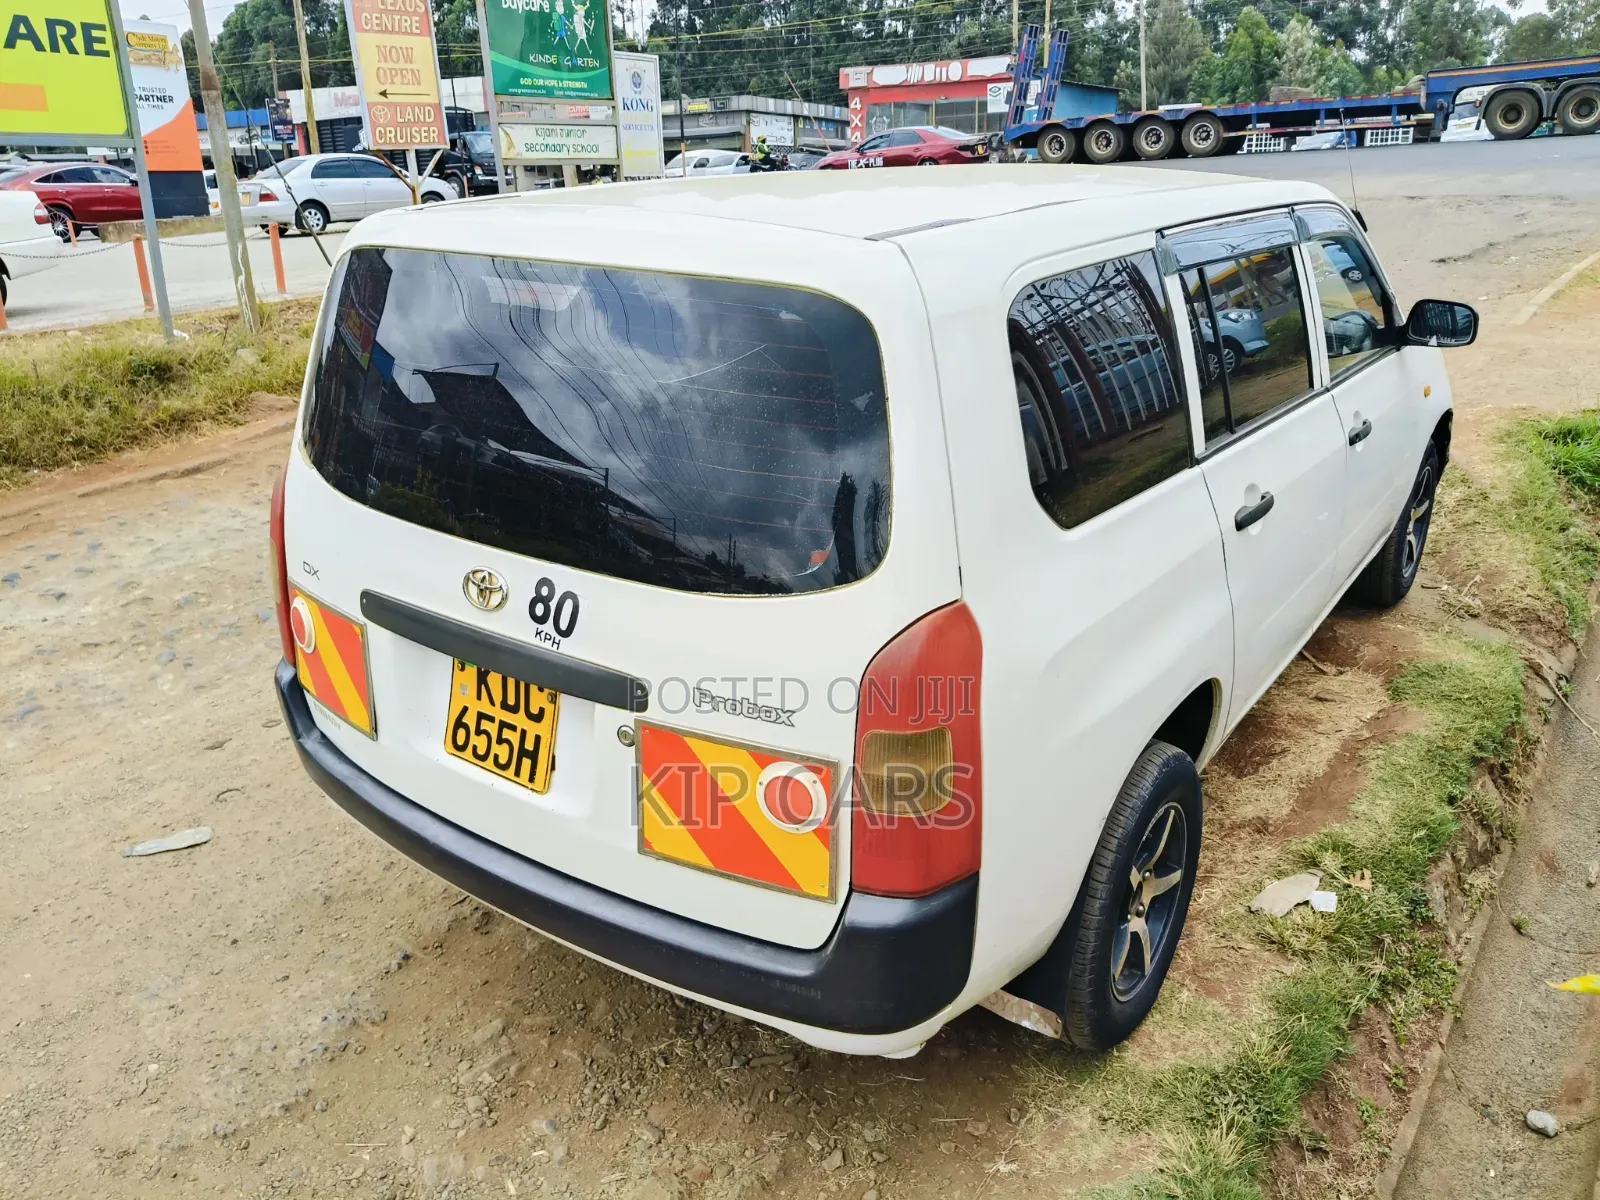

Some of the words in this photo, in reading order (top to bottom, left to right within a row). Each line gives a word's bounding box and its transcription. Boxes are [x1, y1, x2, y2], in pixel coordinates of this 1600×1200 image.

[377, 0, 426, 13] LEXUS
[502, 0, 550, 13] Daycare
[361, 12, 421, 34] CENTRE
[3, 14, 111, 58] ARE
[376, 45, 414, 64] NOW
[376, 66, 422, 86] OPEN
[520, 77, 533, 86] GOD
[533, 79, 545, 87] OUR
[135, 93, 174, 104] PARTNER
[138, 86, 167, 94] TRUSTED
[622, 97, 653, 112] KONG
[396, 105, 435, 123] LAND
[375, 126, 439, 144] CRUISER
[535, 127, 558, 140] Kijani
[524, 142, 571, 155] secondary
[572, 143, 600, 153] school
[302, 560, 321, 581] DX
[528, 576, 580, 639] 80
[534, 627, 561, 651] KPH
[476, 666, 546, 724] KDC
[692, 686, 796, 728] Probox
[451, 704, 542, 784] 655H
